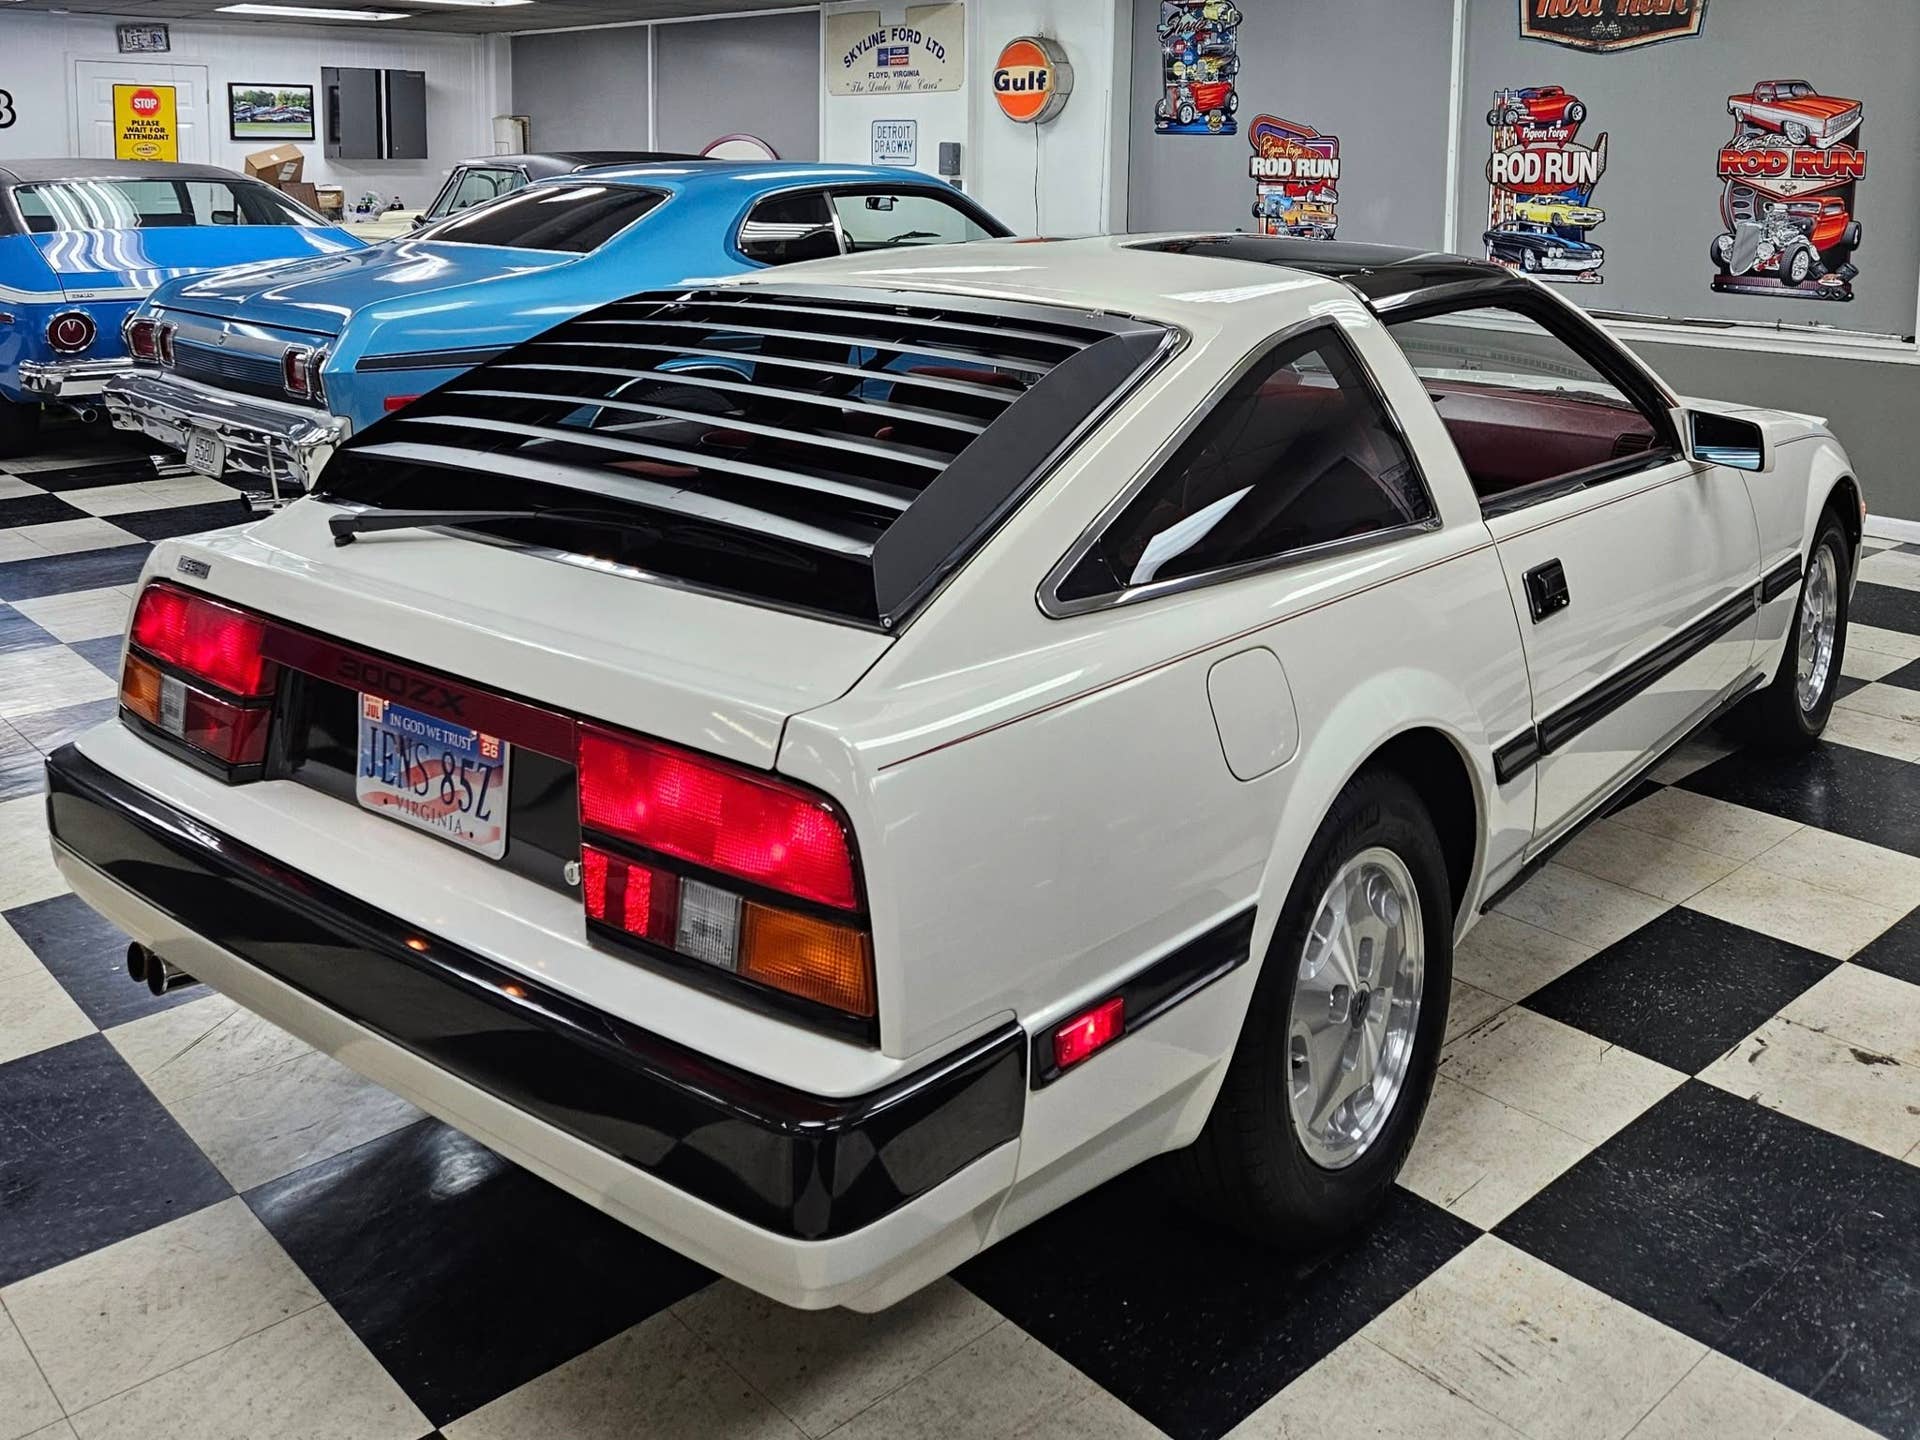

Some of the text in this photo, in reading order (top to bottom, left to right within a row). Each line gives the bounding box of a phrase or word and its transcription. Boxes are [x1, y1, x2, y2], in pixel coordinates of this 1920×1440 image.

[844, 28, 945, 68] SKYLINE FORD LTD.
[893, 70, 920, 78] VIRGINIA
[994, 70, 1047, 91] Gulf
[134, 98, 157, 109] STOP
[877, 126, 910, 139] DETROIT
[1522, 126, 1568, 140] Pigeon Forge
[874, 140, 913, 153] DRAGWAY
[1251, 157, 1339, 178] ROD RUN
[1492, 151, 1597, 183] ROD RUN
[1719, 150, 1866, 177] ROD RUN
[337, 658, 465, 716] 300ZX
[366, 703, 380, 719] JUL
[390, 713, 401, 727] IN
[402, 718, 425, 735] GOD
[427, 725, 442, 740] WE
[441, 730, 471, 751] TRUST
[482, 743, 498, 758] 26
[366, 727, 491, 821] JENS 85Z
[396, 795, 463, 834] VIRGINIA
